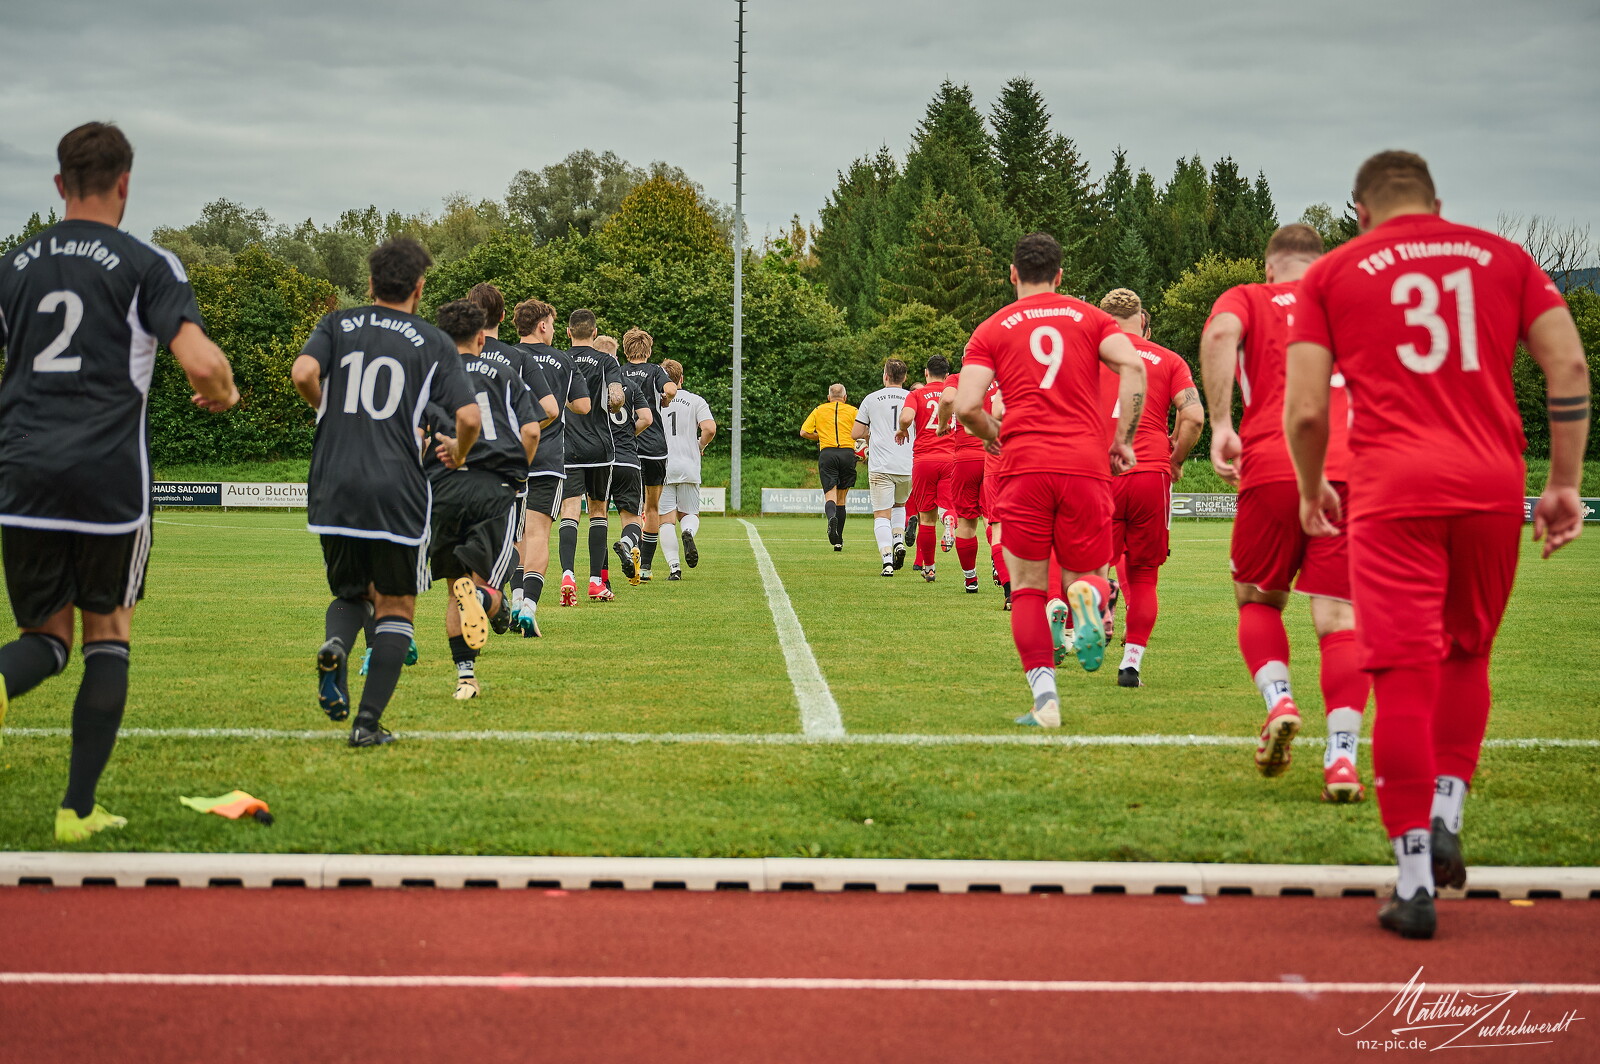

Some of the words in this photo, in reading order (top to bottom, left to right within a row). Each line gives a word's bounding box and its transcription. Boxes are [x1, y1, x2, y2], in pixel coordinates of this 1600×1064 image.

[13, 240, 42, 271] SV
[50, 236, 121, 271] Laufen
[1358, 247, 1396, 275] TSV
[1394, 240, 1493, 267] Tittmoning
[340, 314, 365, 332] SV
[370, 313, 425, 347] Laufen
[1000, 312, 1024, 330] TSV
[1023, 306, 1084, 323] Tittmoning
[1390, 267, 1481, 374] 31
[32, 290, 84, 372] 2
[480, 351, 511, 366] aufen
[533, 355, 562, 370] aufen
[1029, 325, 1064, 390] 9
[1136, 349, 1162, 365] oning
[466, 361, 498, 379] ufen
[340, 351, 406, 420] 10
[671, 398, 691, 407] aufen
[925, 399, 941, 430] 2
[667, 411, 677, 436] 1
[890, 404, 898, 432] 1
[177, 485, 218, 494] SALOMON
[227, 484, 260, 496] Auto
[264, 484, 308, 496] Buchw
[699, 497, 715, 506] NK
[769, 494, 811, 503] Michael
